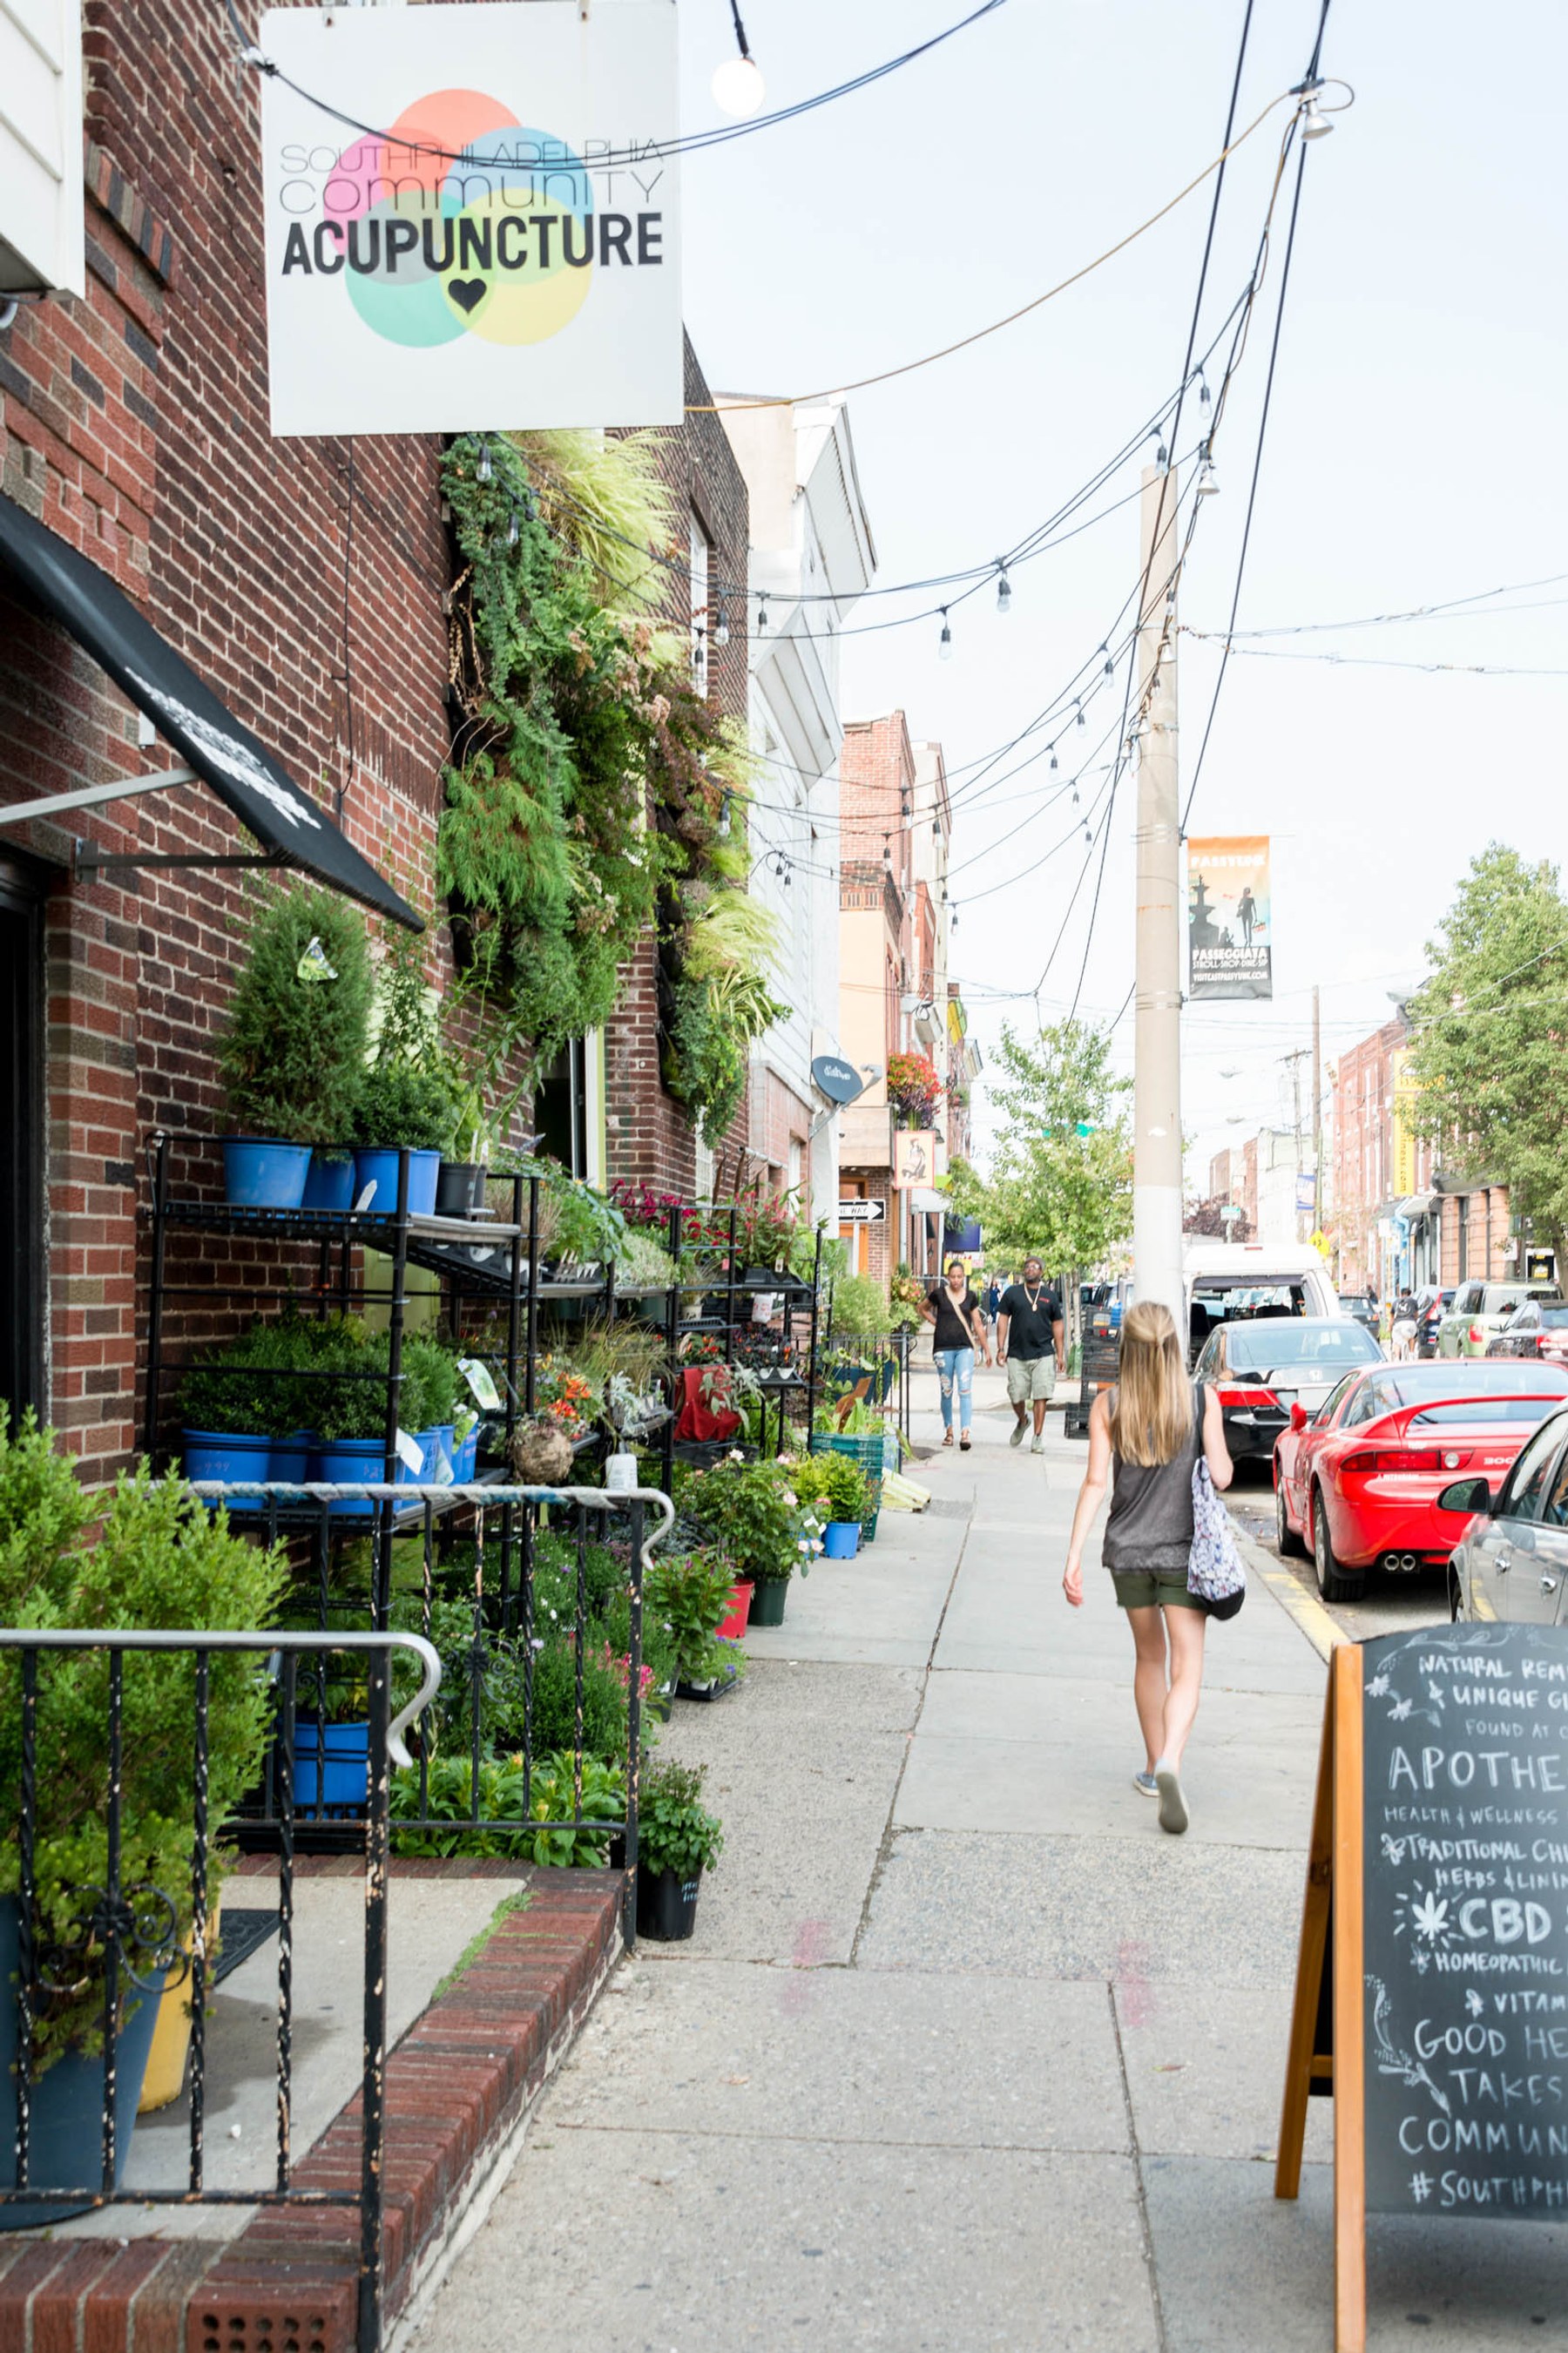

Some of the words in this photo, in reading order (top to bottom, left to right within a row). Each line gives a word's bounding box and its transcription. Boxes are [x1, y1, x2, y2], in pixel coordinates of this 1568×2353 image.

[281, 213, 663, 274] ACUPUNCTURE
[1418, 1654, 1512, 1679] NATURAL
[1520, 1658, 1568, 1682] REM
[1452, 1684, 1539, 1709] UNIQUE
[1465, 1719, 1524, 1738] FOUND
[1532, 1722, 1549, 1740] AT
[1389, 1747, 1568, 1793] APOTHE
[1384, 1806, 1450, 1825] HEALTH
[1470, 1805, 1558, 1826] WELLNESS
[1406, 1832, 1527, 1863] TRADITIONAL
[1436, 1867, 1496, 1890] HERBS
[1459, 1897, 1551, 1944] CBD
[1436, 1952, 1563, 1975] HOMEOPATHIC
[1414, 2018, 1506, 2059] GOOD
[1449, 2068, 1562, 2108] TAKES
[1408, 2170, 1568, 2208] #SOUTHPH
